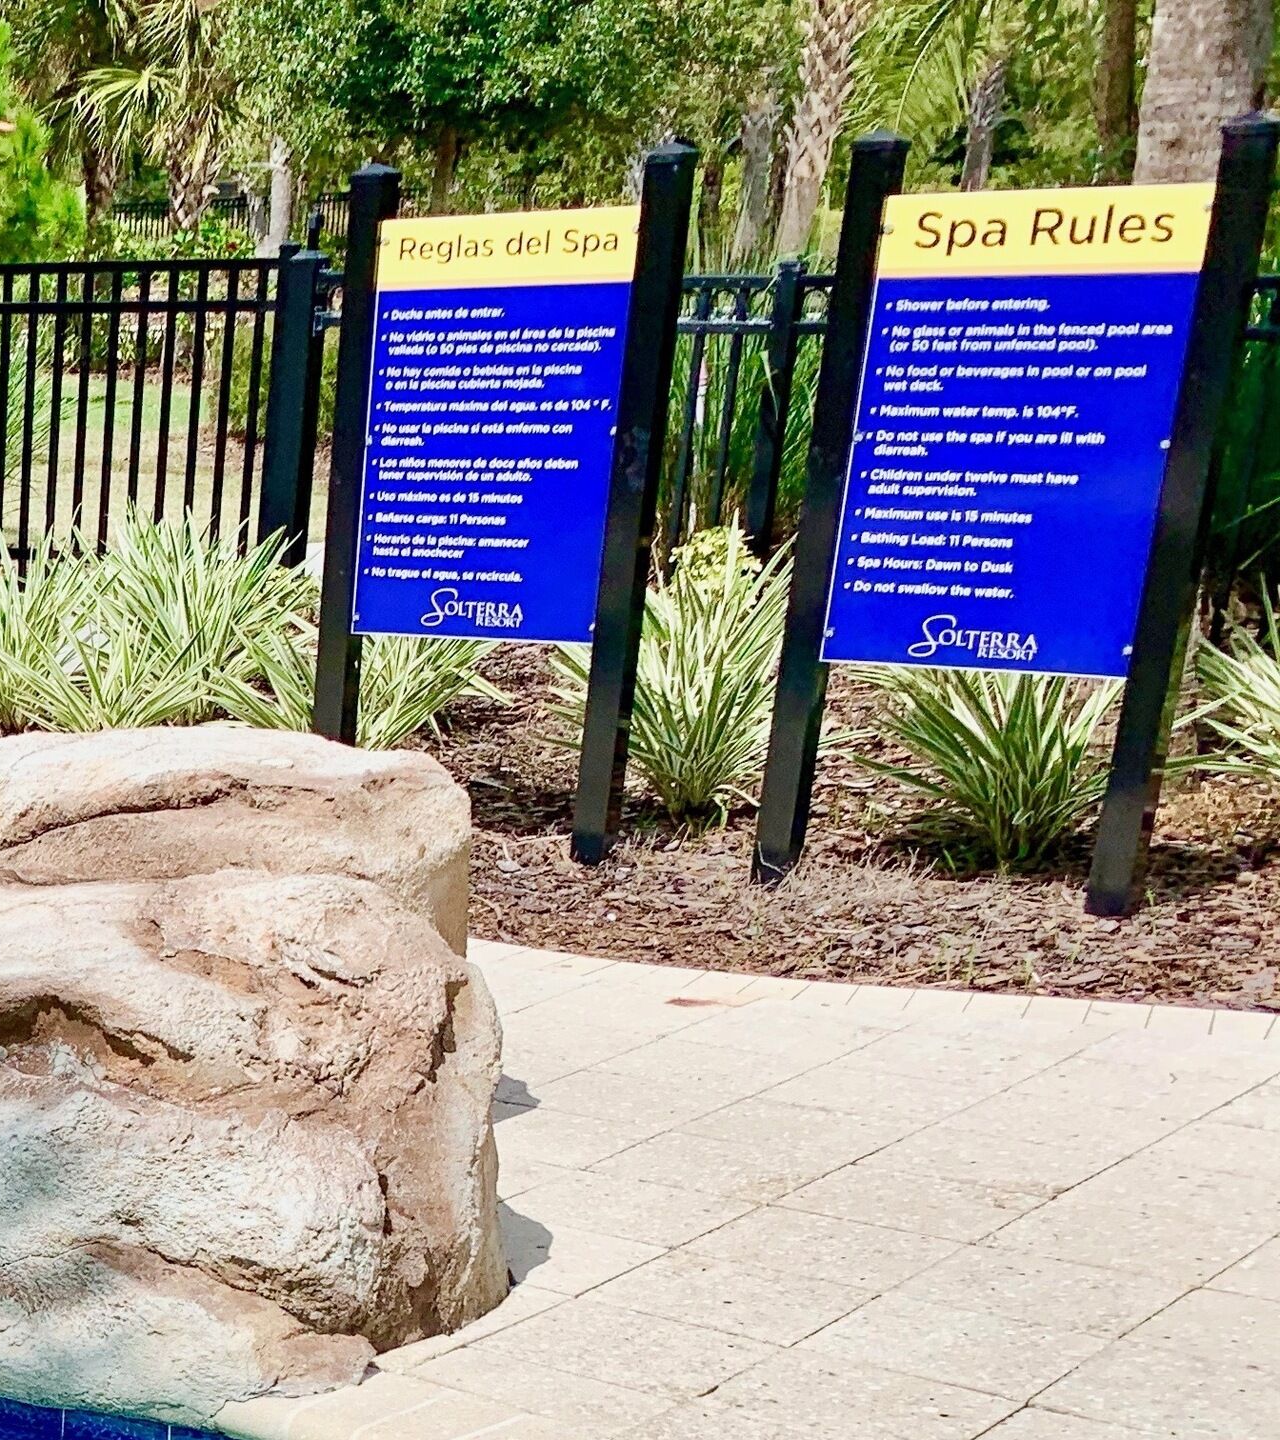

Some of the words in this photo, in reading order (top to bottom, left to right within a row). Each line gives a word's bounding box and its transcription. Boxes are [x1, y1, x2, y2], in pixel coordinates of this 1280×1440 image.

[914, 211, 1008, 256] Spa
[1029, 204, 1176, 246] Rules
[399, 234, 494, 264] Reglas
[505, 230, 551, 256] del
[562, 229, 619, 258] Spa
[895, 299, 945, 312] Shower
[946, 298, 990, 311] before
[991, 297, 1051, 312] entering.
[391, 308, 424, 321] Ducha
[424, 309, 453, 320] antes
[406, 330, 436, 342] vidrio
[446, 330, 493, 342] animales
[521, 328, 546, 340] área
[576, 326, 616, 340] piscina
[891, 326, 911, 338] No
[913, 325, 946, 339] glass
[948, 326, 964, 337] or
[964, 324, 1015, 337] animals
[1017, 324, 1031, 336] in
[1033, 324, 1056, 336] the
[1058, 323, 1106, 336] fenced
[1106, 323, 1140, 338] pool
[1141, 325, 1173, 336] area
[388, 344, 424, 356] vallada
[440, 343, 454, 355] 50
[455, 343, 478, 356] pies
[495, 342, 533, 355] piscina
[889, 340, 910, 353] (or
[911, 340, 930, 352] 50
[931, 339, 958, 352] feet
[960, 339, 992, 352] from
[993, 338, 1057, 352] unfenced
[1057, 338, 1099, 353] pool).
[403, 366, 422, 379] hay
[423, 365, 462, 377] comida
[472, 364, 515, 377] bebidas
[543, 363, 582, 377] piscina
[885, 365, 905, 377] No
[907, 365, 939, 377] food
[939, 367, 955, 377] or
[956, 365, 1024, 379] beverages
[1026, 365, 1040, 377] in
[1041, 364, 1074, 380] pool
[1075, 367, 1092, 377] or
[1093, 367, 1112, 377] on
[1113, 364, 1147, 380] pool
[420, 379, 457, 392] piscina
[457, 378, 501, 390] cubierta
[883, 380, 908, 392] wet
[909, 379, 944, 392] deck.
[383, 400, 448, 414] Temperatura
[448, 399, 490, 412] máxima
[490, 400, 508, 412] del
[571, 399, 591, 411] 104
[879, 405, 940, 417] Maximum
[942, 406, 981, 418] water
[982, 405, 1020, 420] temp.
[1022, 405, 1034, 418] is
[398, 425, 421, 434] usar
[433, 423, 470, 435] piscina
[505, 422, 551, 434] enfermo
[552, 424, 573, 435] con
[876, 430, 895, 442] Do
[897, 431, 919, 442] not
[921, 432, 944, 443] use
[946, 431, 968, 443] the
[969, 432, 993, 445] spa
[995, 431, 1007, 443] if
[1007, 433, 1034, 445] you
[1035, 433, 1058, 444] are
[1060, 432, 1074, 445] ill
[1075, 432, 1106, 445] with
[379, 457, 398, 468] Los
[399, 457, 426, 468] niños
[427, 459, 472, 469] menores
[488, 457, 516, 469] doce
[516, 458, 543, 470] años
[543, 458, 579, 470] deben
[378, 470, 405, 481] tener
[406, 470, 464, 482] supervisión
[480, 472, 495, 482] un
[870, 469, 923, 481] Children
[925, 470, 963, 482] under
[964, 471, 1008, 483] twelve
[1010, 472, 1044, 484] must
[1045, 472, 1079, 485] have
[377, 491, 396, 502] Uso
[397, 491, 438, 502] máximo
[439, 493, 451, 503] es
[452, 492, 467, 503] de
[468, 492, 480, 503] 15
[481, 493, 524, 504] minutos
[867, 483, 900, 495] adult
[902, 484, 977, 497] supervision.
[416, 515, 447, 526] carga:
[449, 514, 458, 525] 11
[459, 514, 507, 526] Personas
[864, 507, 924, 520] Maximum
[926, 509, 949, 521] use
[951, 509, 962, 521] is
[965, 510, 979, 522] 15
[980, 511, 1033, 524] minutes
[373, 534, 411, 545] Horario
[412, 535, 426, 546] de
[427, 535, 437, 546] la
[438, 536, 477, 548] piscina:
[478, 539, 529, 549] amanecer
[860, 532, 909, 547] Bathing
[911, 534, 947, 547] Load:
[949, 535, 960, 547] 11
[962, 535, 1013, 549] Persons
[372, 546, 400, 557] hasta
[400, 547, 411, 557] el
[412, 547, 465, 559] anochecer
[857, 556, 882, 570] Spa
[883, 557, 923, 570] Hours:
[925, 559, 962, 572] Dawn
[964, 560, 979, 573] to
[980, 561, 1014, 574] Dusk
[371, 567, 386, 577] No
[421, 568, 432, 579] el
[462, 573, 474, 581] se
[853, 580, 872, 592] Do
[873, 582, 896, 593] not
[897, 583, 948, 596] swallow
[950, 585, 971, 597] the
[420, 588, 524, 627] SOLTERRA
[475, 616, 521, 628] RESORT
[907, 614, 1039, 658] SOLTERRA
[977, 647, 1036, 662] RESORT
